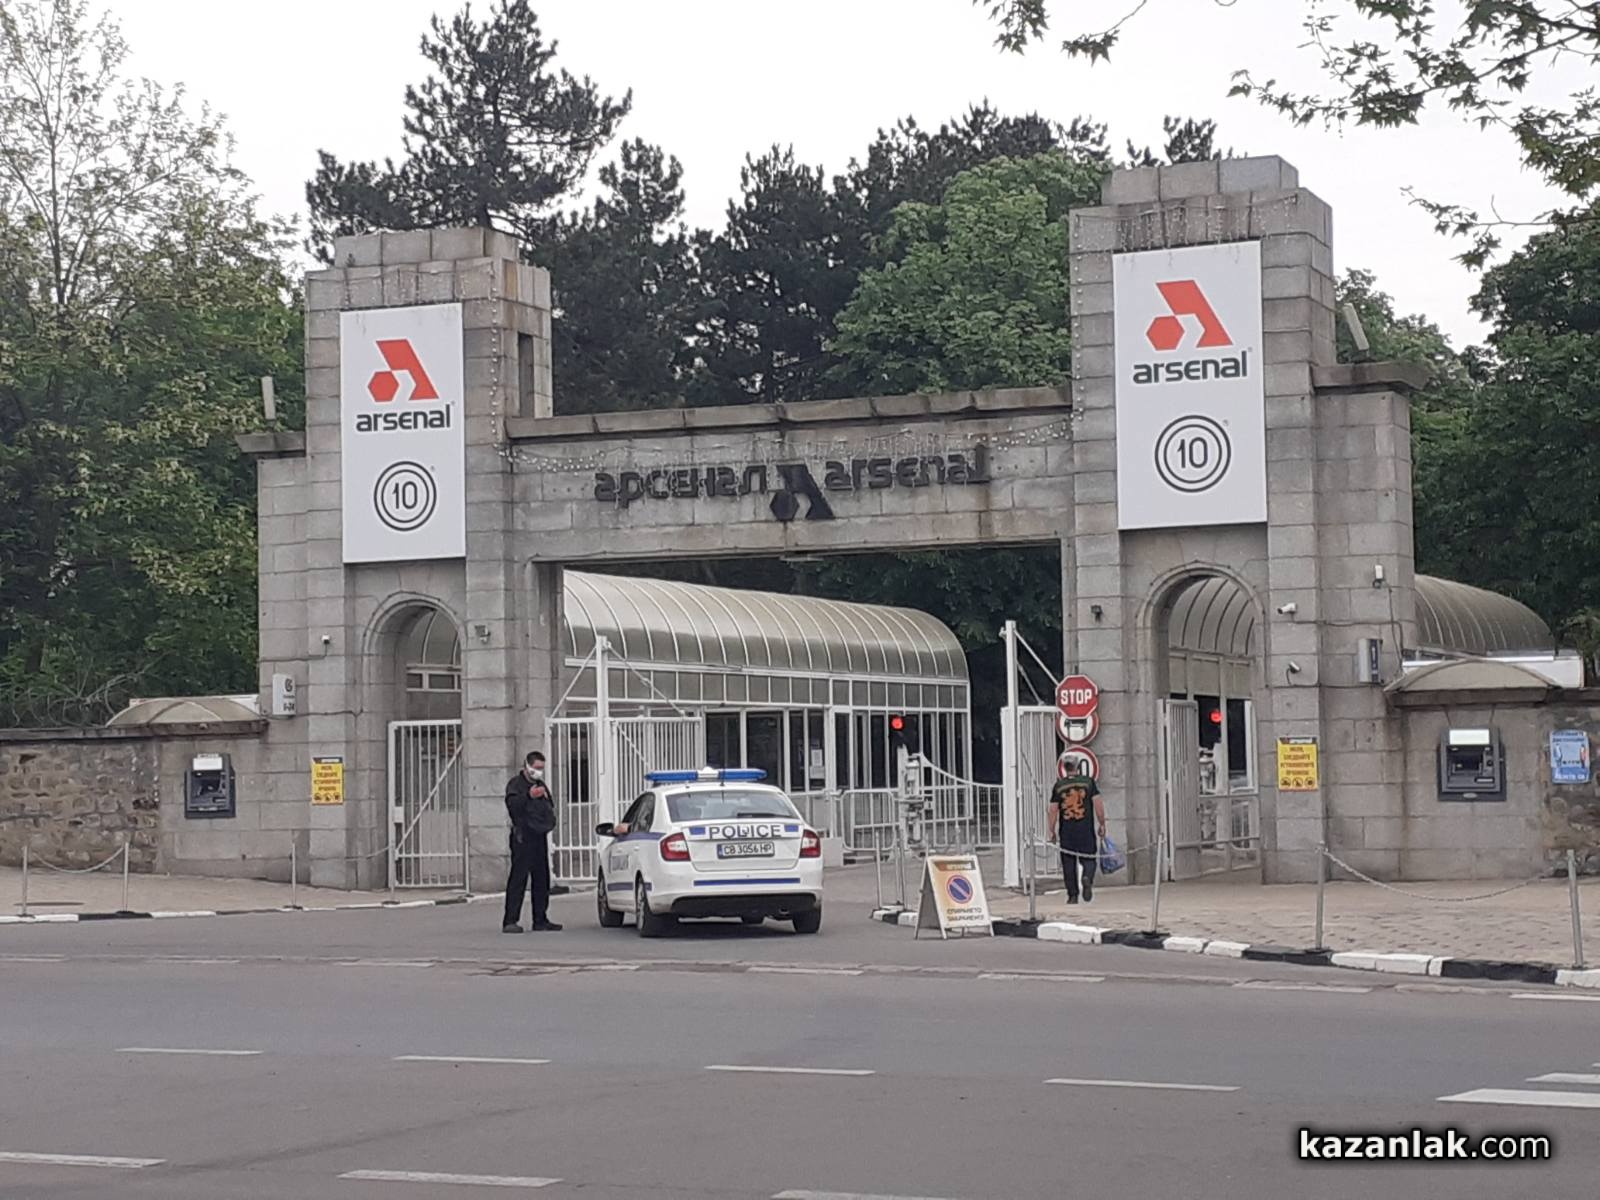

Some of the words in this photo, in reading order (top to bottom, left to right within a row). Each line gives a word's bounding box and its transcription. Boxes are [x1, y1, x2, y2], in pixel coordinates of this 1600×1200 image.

[1133, 350, 1247, 384] arsenal
[356, 404, 450, 432] arsenal
[1177, 437, 1208, 468] 10
[392, 481, 418, 510] 10
[1060, 689, 1092, 705] STOP
[709, 824, 782, 840] POLICE
